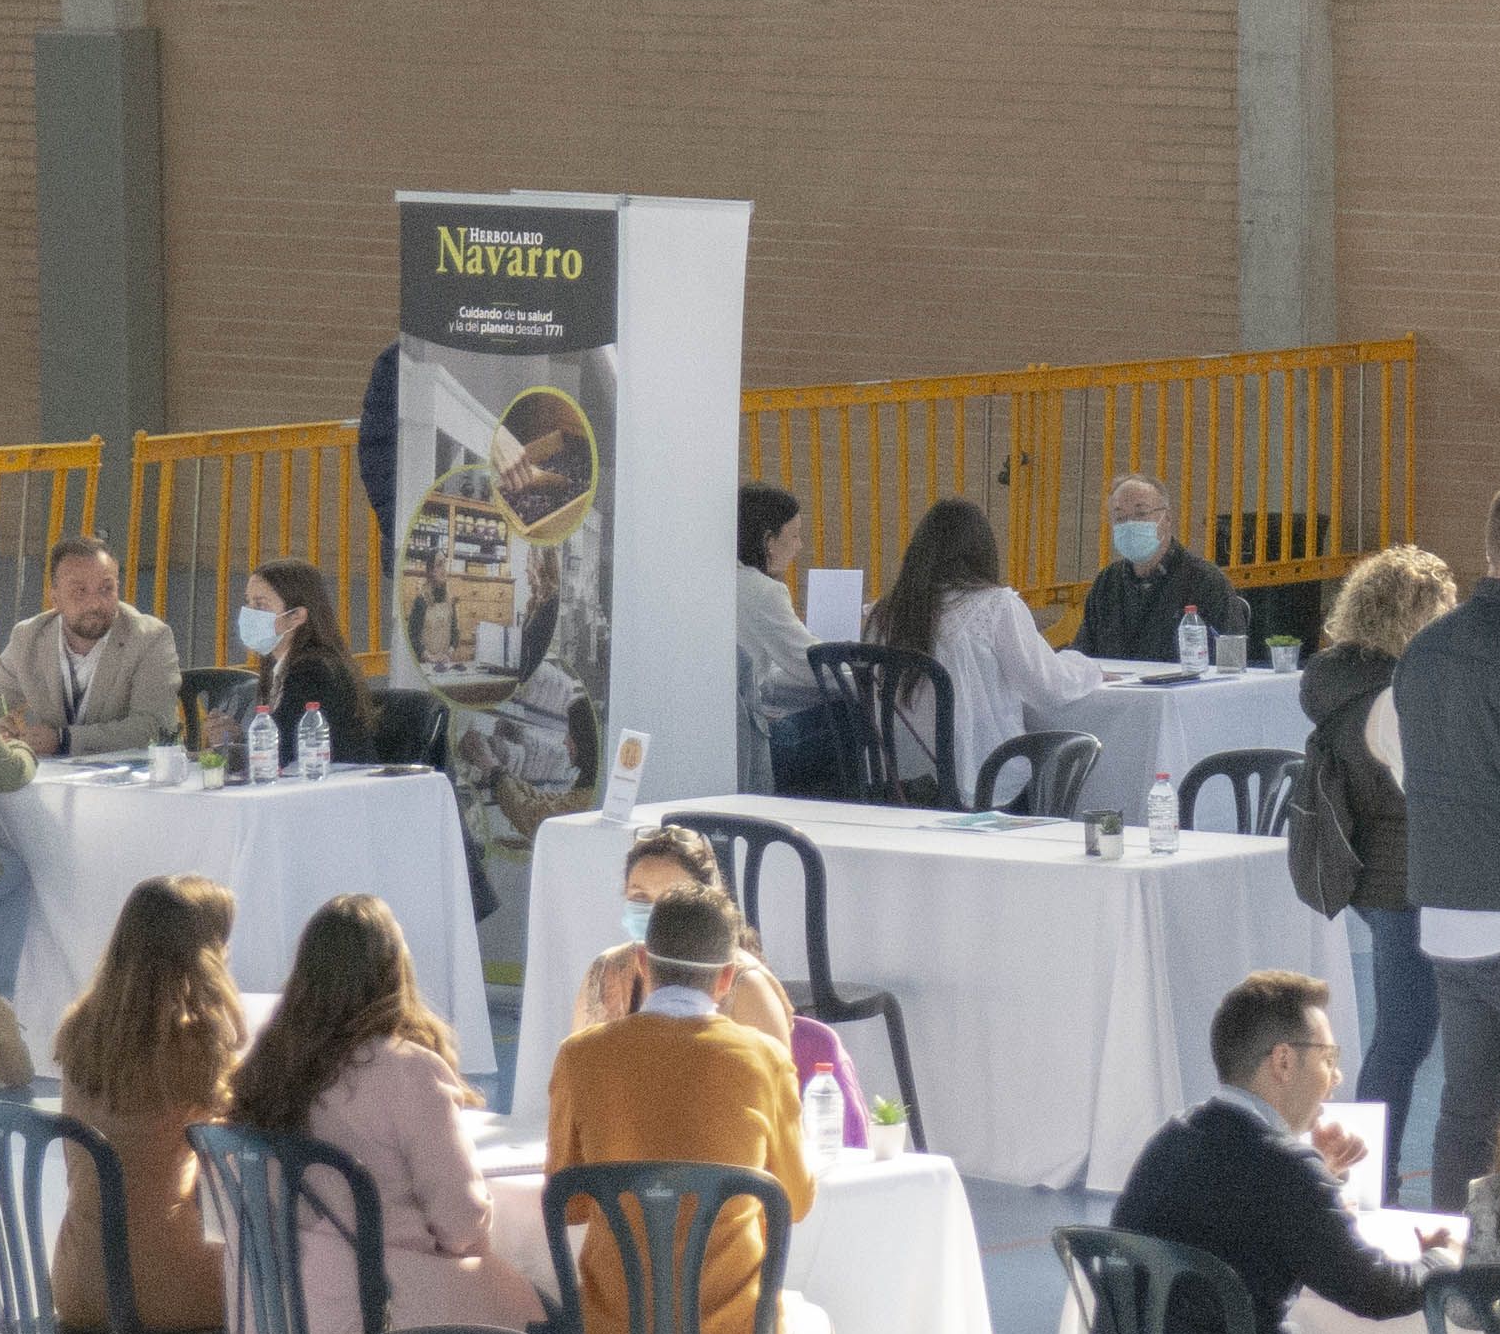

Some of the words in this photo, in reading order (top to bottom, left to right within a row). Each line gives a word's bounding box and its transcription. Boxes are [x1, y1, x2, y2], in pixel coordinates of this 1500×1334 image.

[469, 227, 543, 245] HERBOLARIO
[436, 226, 583, 280] Navarro
[459, 305, 502, 320] Cuidando
[504, 309, 516, 320] de
[517, 309, 526, 321] tu
[528, 309, 553, 323] salud
[456, 320, 464, 331] la
[466, 321, 480, 332] del
[480, 322, 514, 336] planeta
[515, 323, 543, 336] desde
[545, 325, 563, 337] 1771
